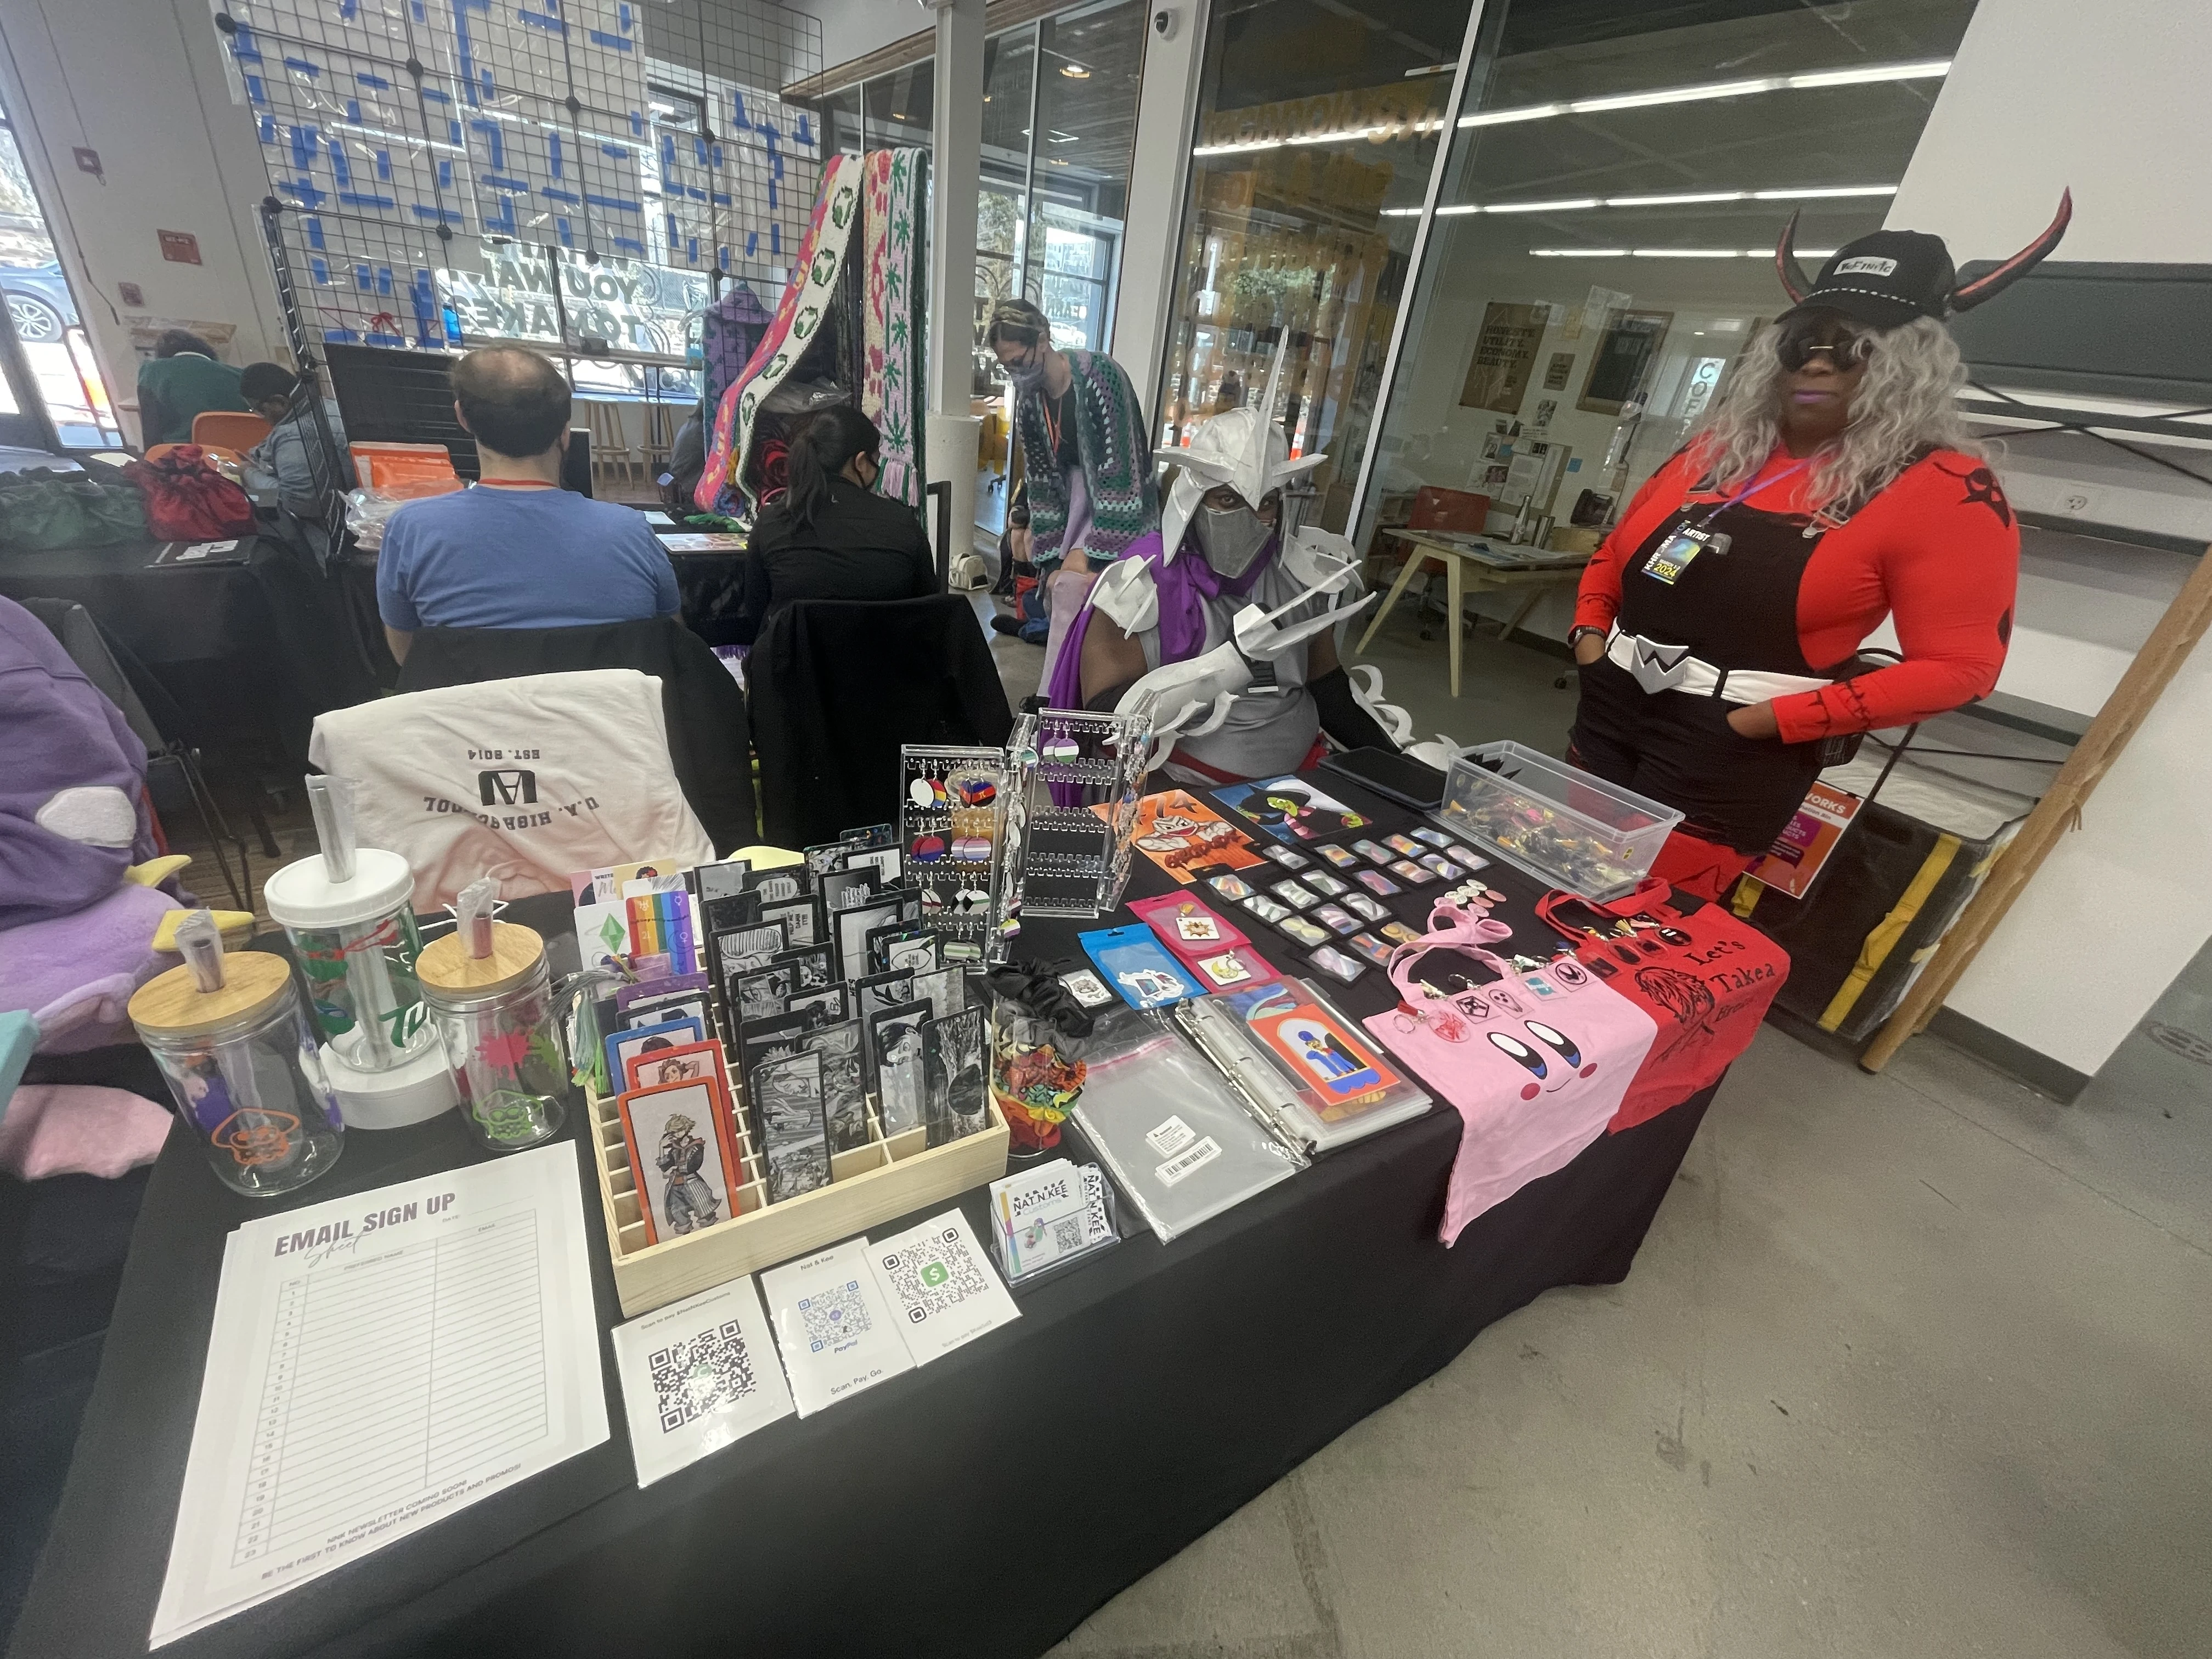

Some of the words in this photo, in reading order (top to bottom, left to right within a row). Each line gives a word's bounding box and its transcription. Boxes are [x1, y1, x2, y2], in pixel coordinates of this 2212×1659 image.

[1682, 528, 1711, 541] ARTIST
[1654, 563, 1677, 577] 2024
[508, 749, 540, 760] EST.
[424, 797, 500, 830] SCOOL
[1683, 941, 1746, 966] Let's
[1087, 1175, 1096, 1197] NAT
[1013, 1194, 1036, 1211] NAT
[1037, 1194, 1045, 1203] N
[1048, 1184, 1069, 1199] KEE
[1023, 1198, 1062, 1216] Customs
[274, 1220, 354, 1257] EMAIL
[363, 1202, 417, 1232] SIGN
[427, 1193, 456, 1215] UP
[1091, 1212, 1101, 1235] KEE
[304, 1231, 373, 1268] Sheet
[343, 1256, 382, 1270] PREFERRED
[383, 1250, 404, 1259] NAME
[800, 1262, 812, 1271] Nat
[641, 1321, 656, 1330] Scan
[834, 1339, 858, 1353] PayPal
[348, 1508, 404, 1535] NEWSLETTER
[405, 1492, 439, 1510] COMING
[261, 1570, 273, 1579] BE
[277, 1561, 294, 1573] THE
[296, 1550, 322, 1565] FIRST
[325, 1544, 337, 1554] TO
[339, 1532, 366, 1548] KNOW
[368, 1517, 398, 1536] ABOUT
[399, 1509, 419, 1522] NEW
[421, 1488, 465, 1512] PRODUCTS
[467, 1480, 484, 1492] AND
